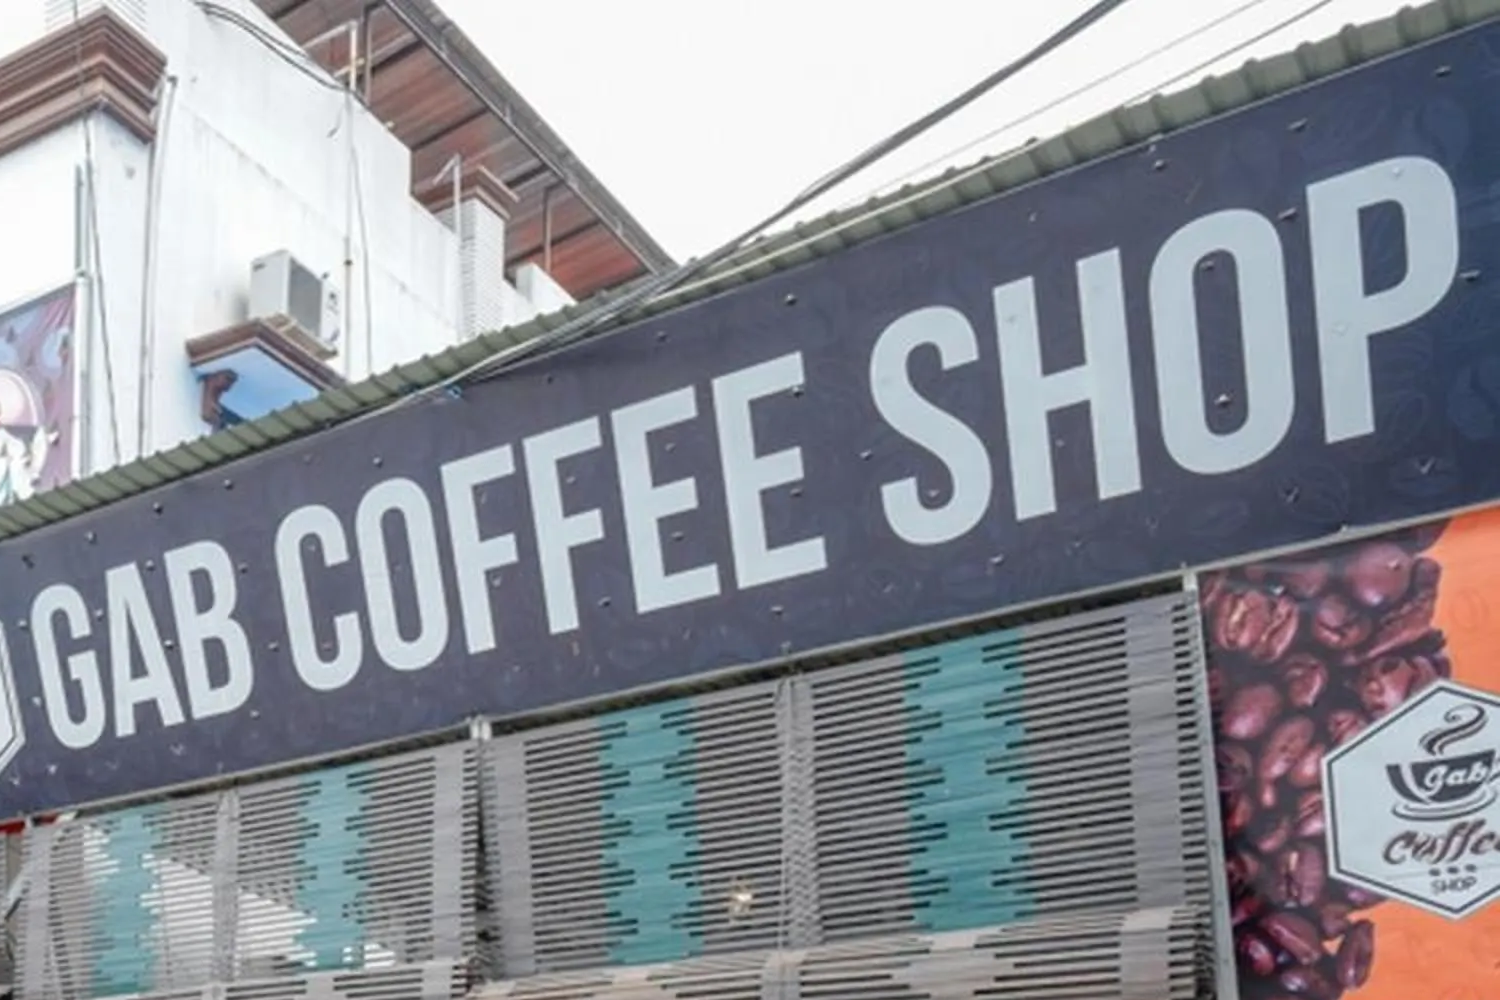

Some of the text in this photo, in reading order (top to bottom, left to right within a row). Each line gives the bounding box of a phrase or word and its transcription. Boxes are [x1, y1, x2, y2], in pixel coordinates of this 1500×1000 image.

[29, 156, 1459, 749] GAB COFFEE SHOP
[1423, 757, 1486, 799] Gab
[1383, 818, 1500, 865] Coffe
[1431, 875, 1477, 894] SHOP
